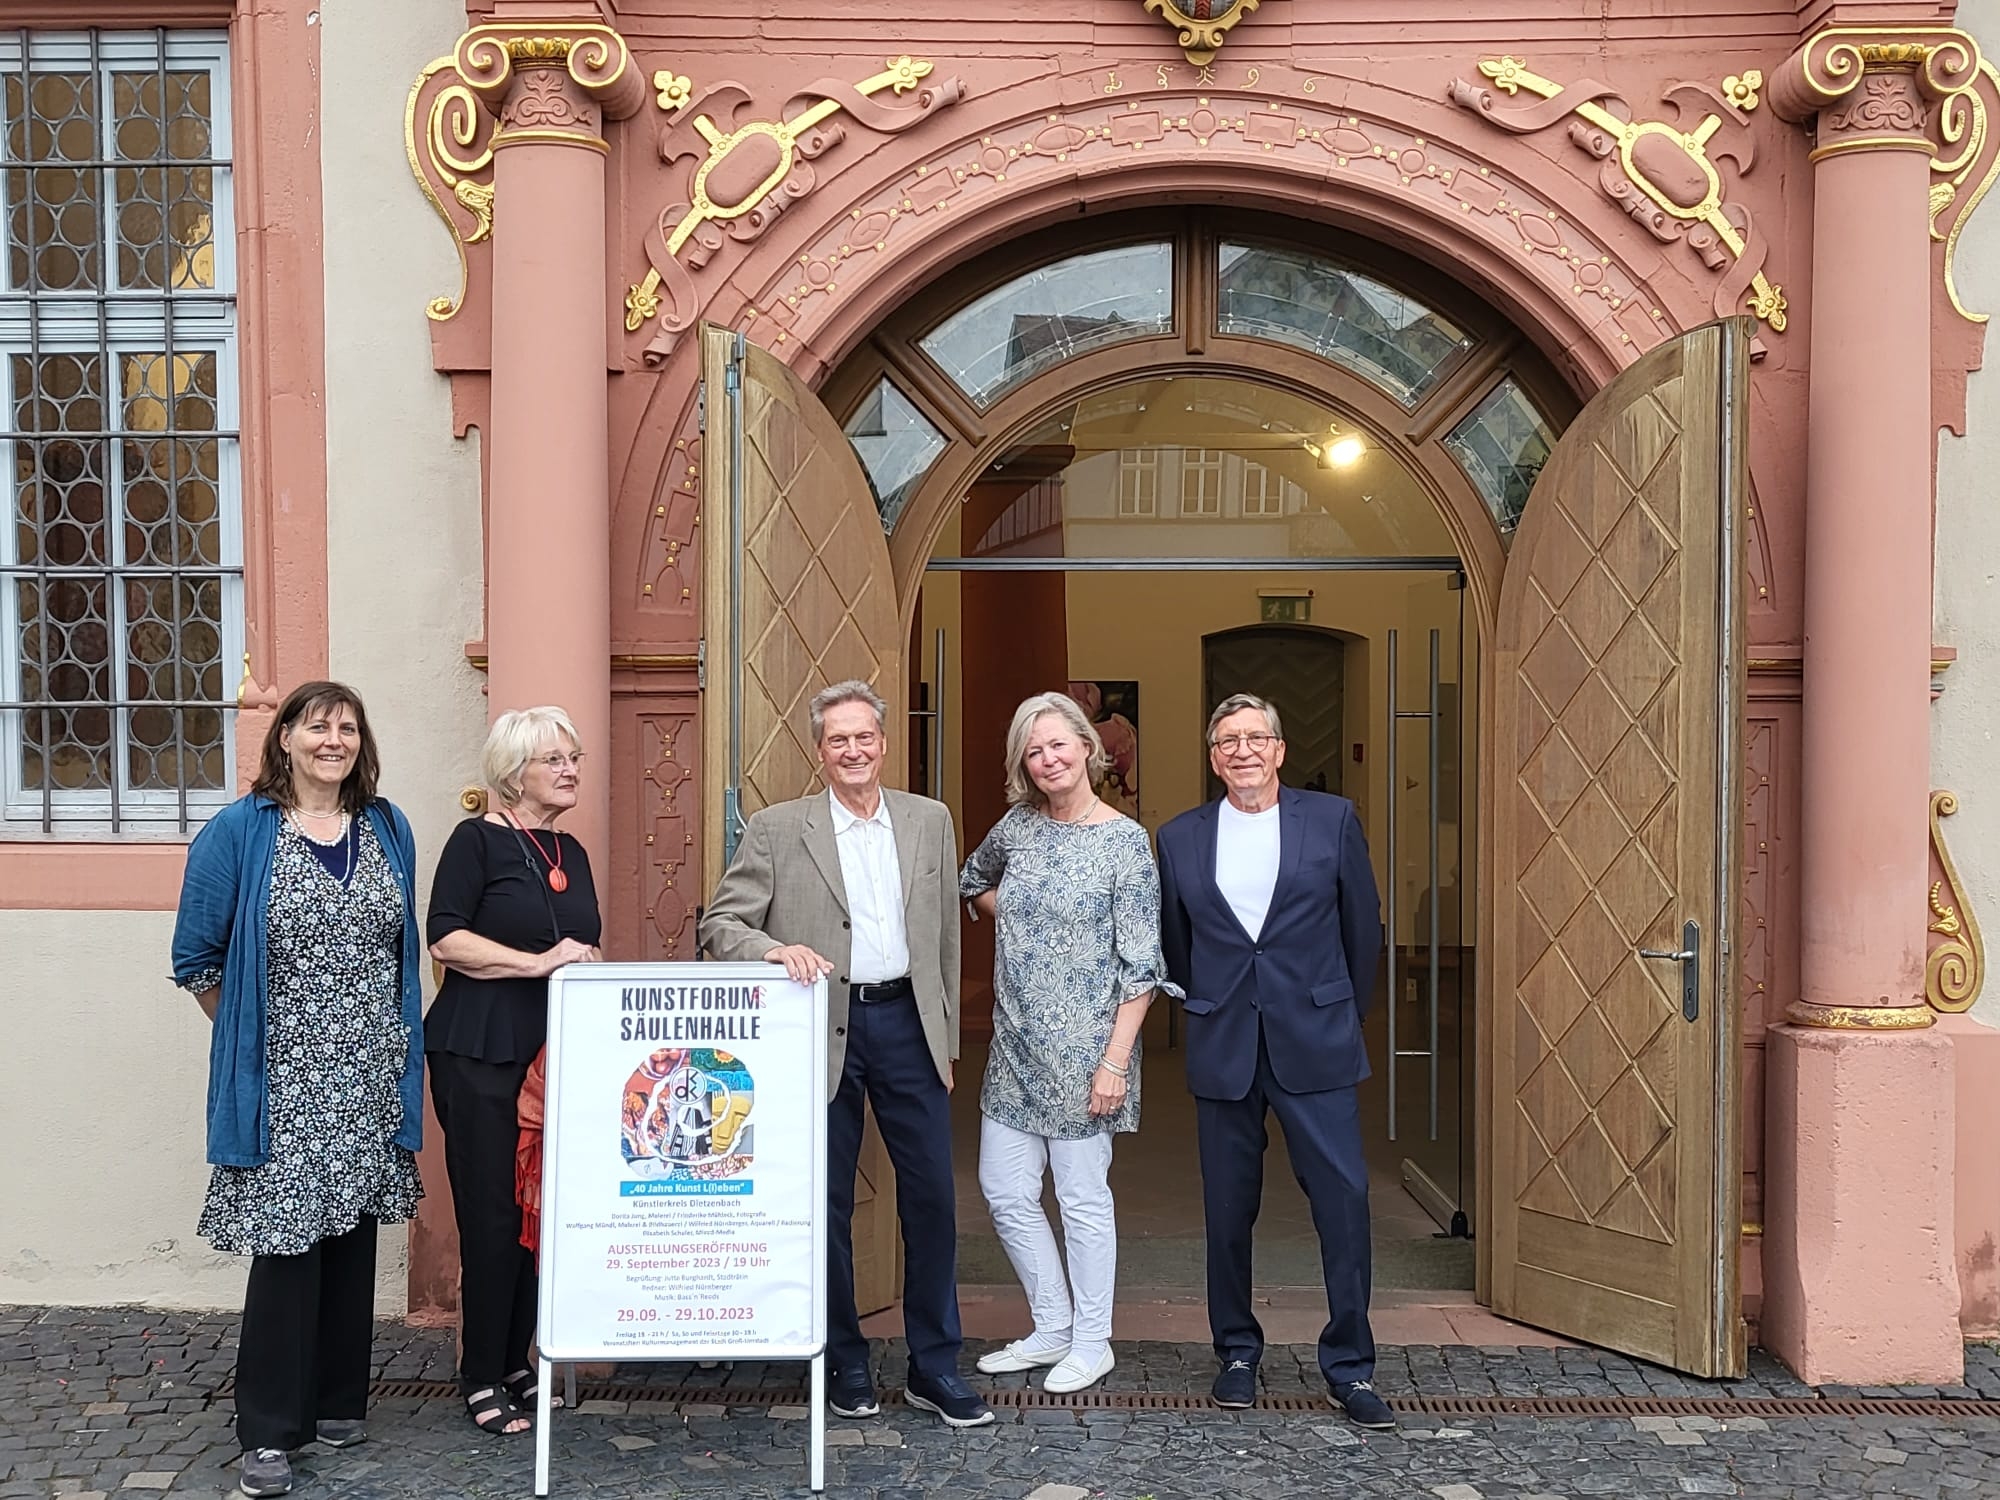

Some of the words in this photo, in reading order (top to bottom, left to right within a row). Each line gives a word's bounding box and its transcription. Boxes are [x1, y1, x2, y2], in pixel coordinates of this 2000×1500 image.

[622, 987, 760, 1011] KUNSTFORUM
[621, 1013, 760, 1041] SÄULENHALLE
[648, 1183, 673, 1193] Jahre
[676, 1183, 701, 1193] Kunst
[633, 1200, 687, 1208] Künstlerkreis
[690, 1199, 740, 1207] Dietzenbach
[608, 1241, 767, 1255] AUSSTELLUNGSERÖFFNUNG
[607, 1260, 623, 1269] 29.
[627, 1258, 689, 1271] September
[693, 1258, 720, 1268] 2023
[733, 1258, 747, 1267] 19
[750, 1257, 770, 1268] Uhr
[695, 1283, 732, 1291] Nürnberger
[617, 1310, 661, 1321] 29.09.
[675, 1308, 753, 1320] 29.10.2023
